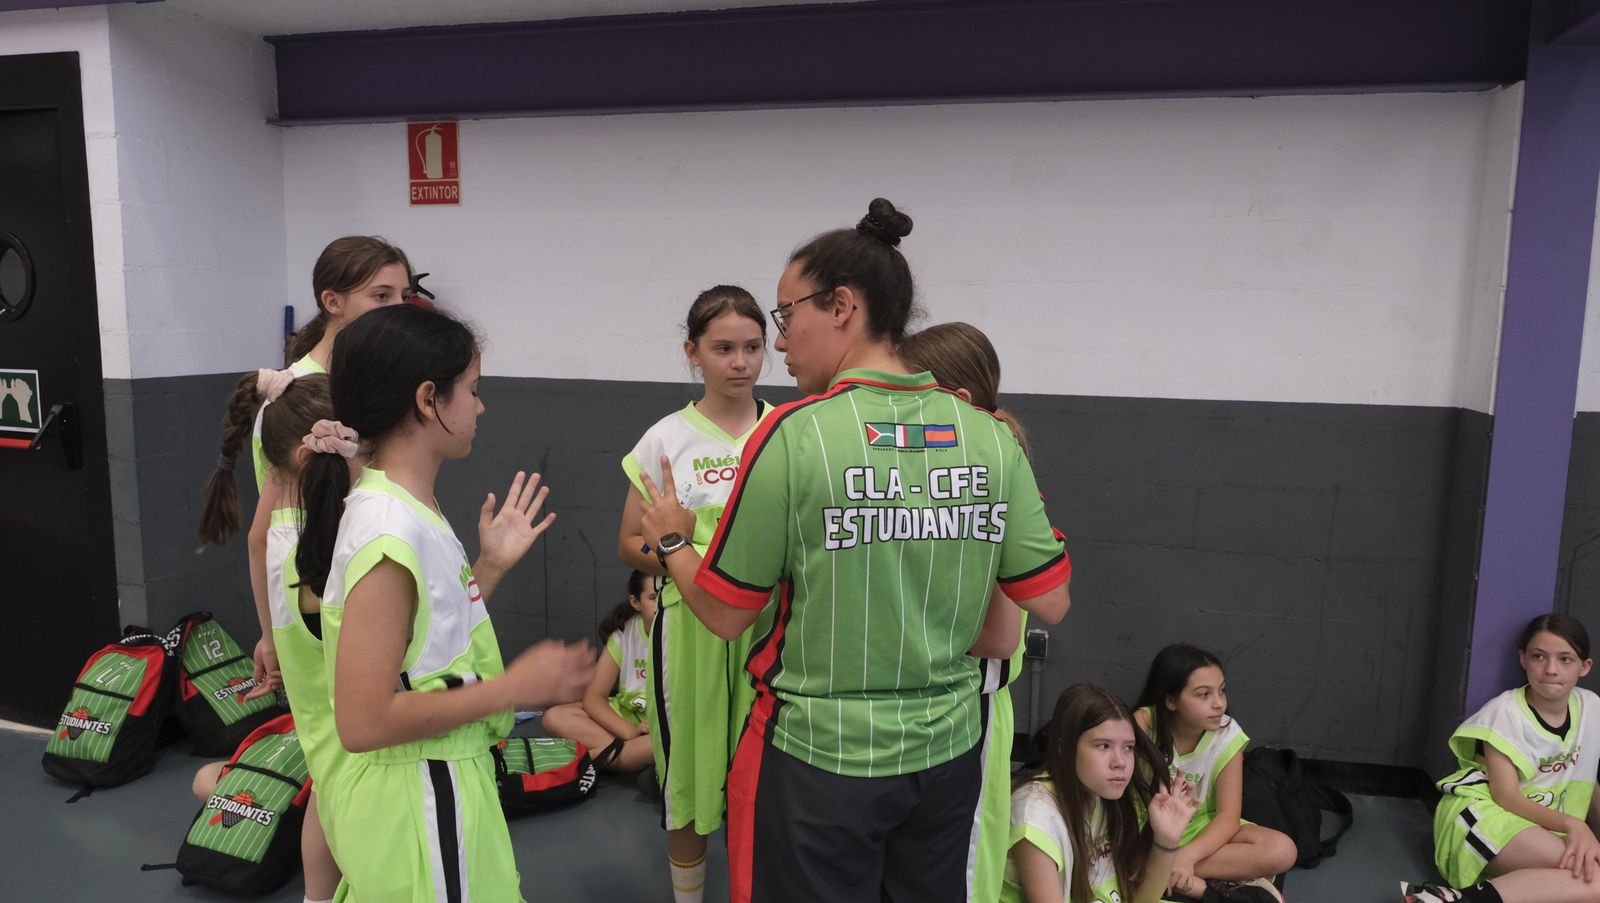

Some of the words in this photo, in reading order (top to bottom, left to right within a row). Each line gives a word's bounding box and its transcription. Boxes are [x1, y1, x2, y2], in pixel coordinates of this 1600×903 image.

[411, 185, 458, 200] EXTINTOR
[703, 466, 739, 484] CO
[844, 466, 906, 501] CLA
[928, 465, 990, 500] CFE
[822, 501, 1008, 551] ESTUDIANTES
[202, 639, 225, 661] 12
[213, 677, 265, 701] ESTUDIANT
[58, 713, 112, 735] STUDIANTES
[206, 795, 275, 827] ESTUDIANTES
